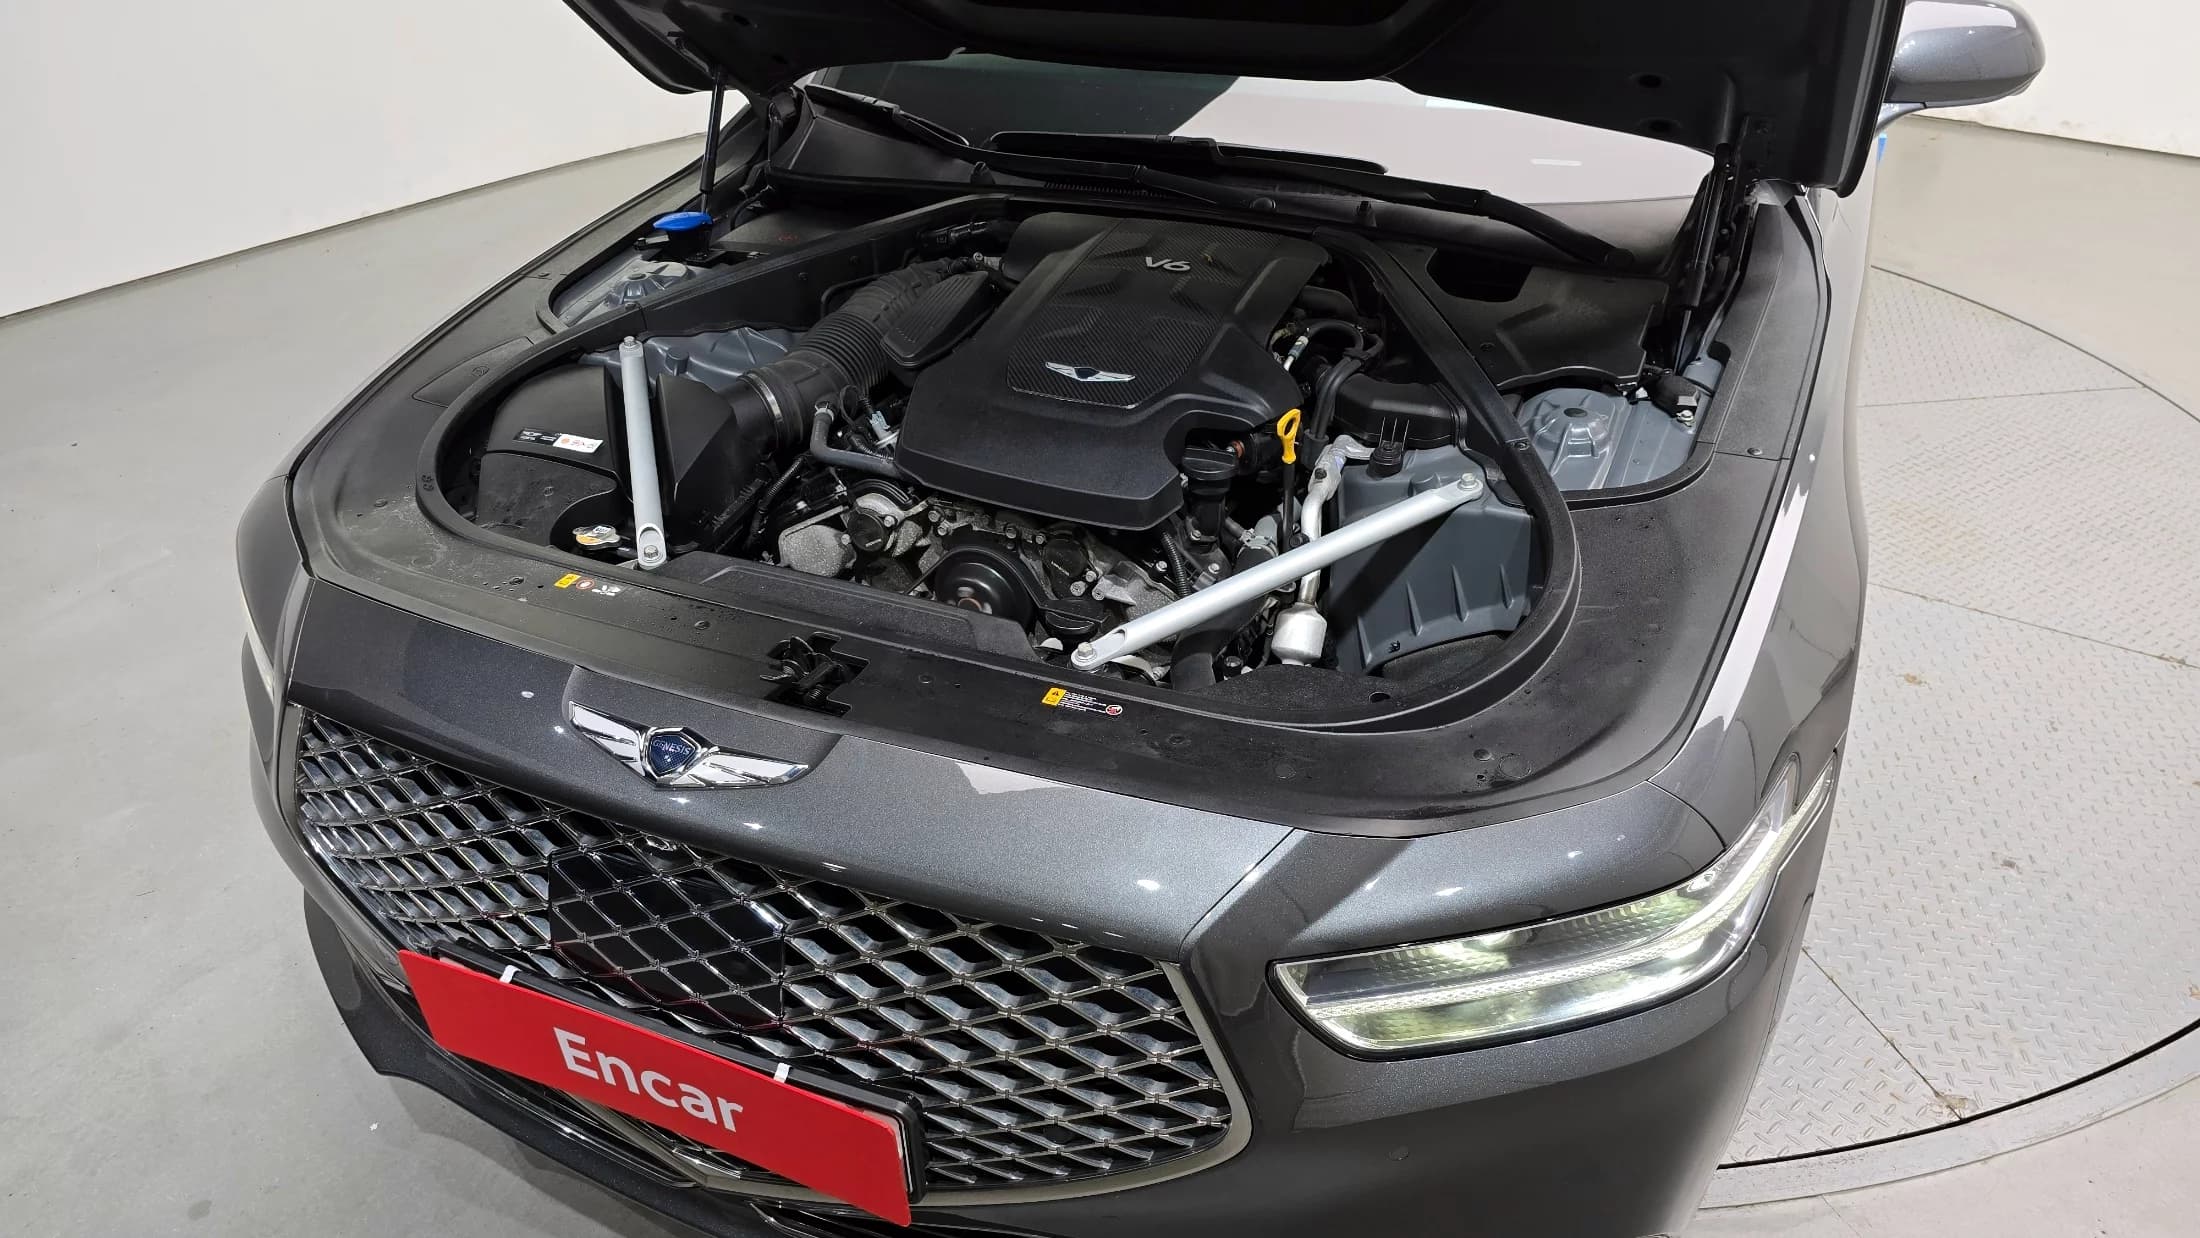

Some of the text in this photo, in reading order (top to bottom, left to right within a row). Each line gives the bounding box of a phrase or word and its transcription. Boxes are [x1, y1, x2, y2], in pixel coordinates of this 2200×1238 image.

[1145, 256, 1191, 272] V6
[652, 739, 691, 755] GENESIS
[553, 1026, 744, 1133] Encar
